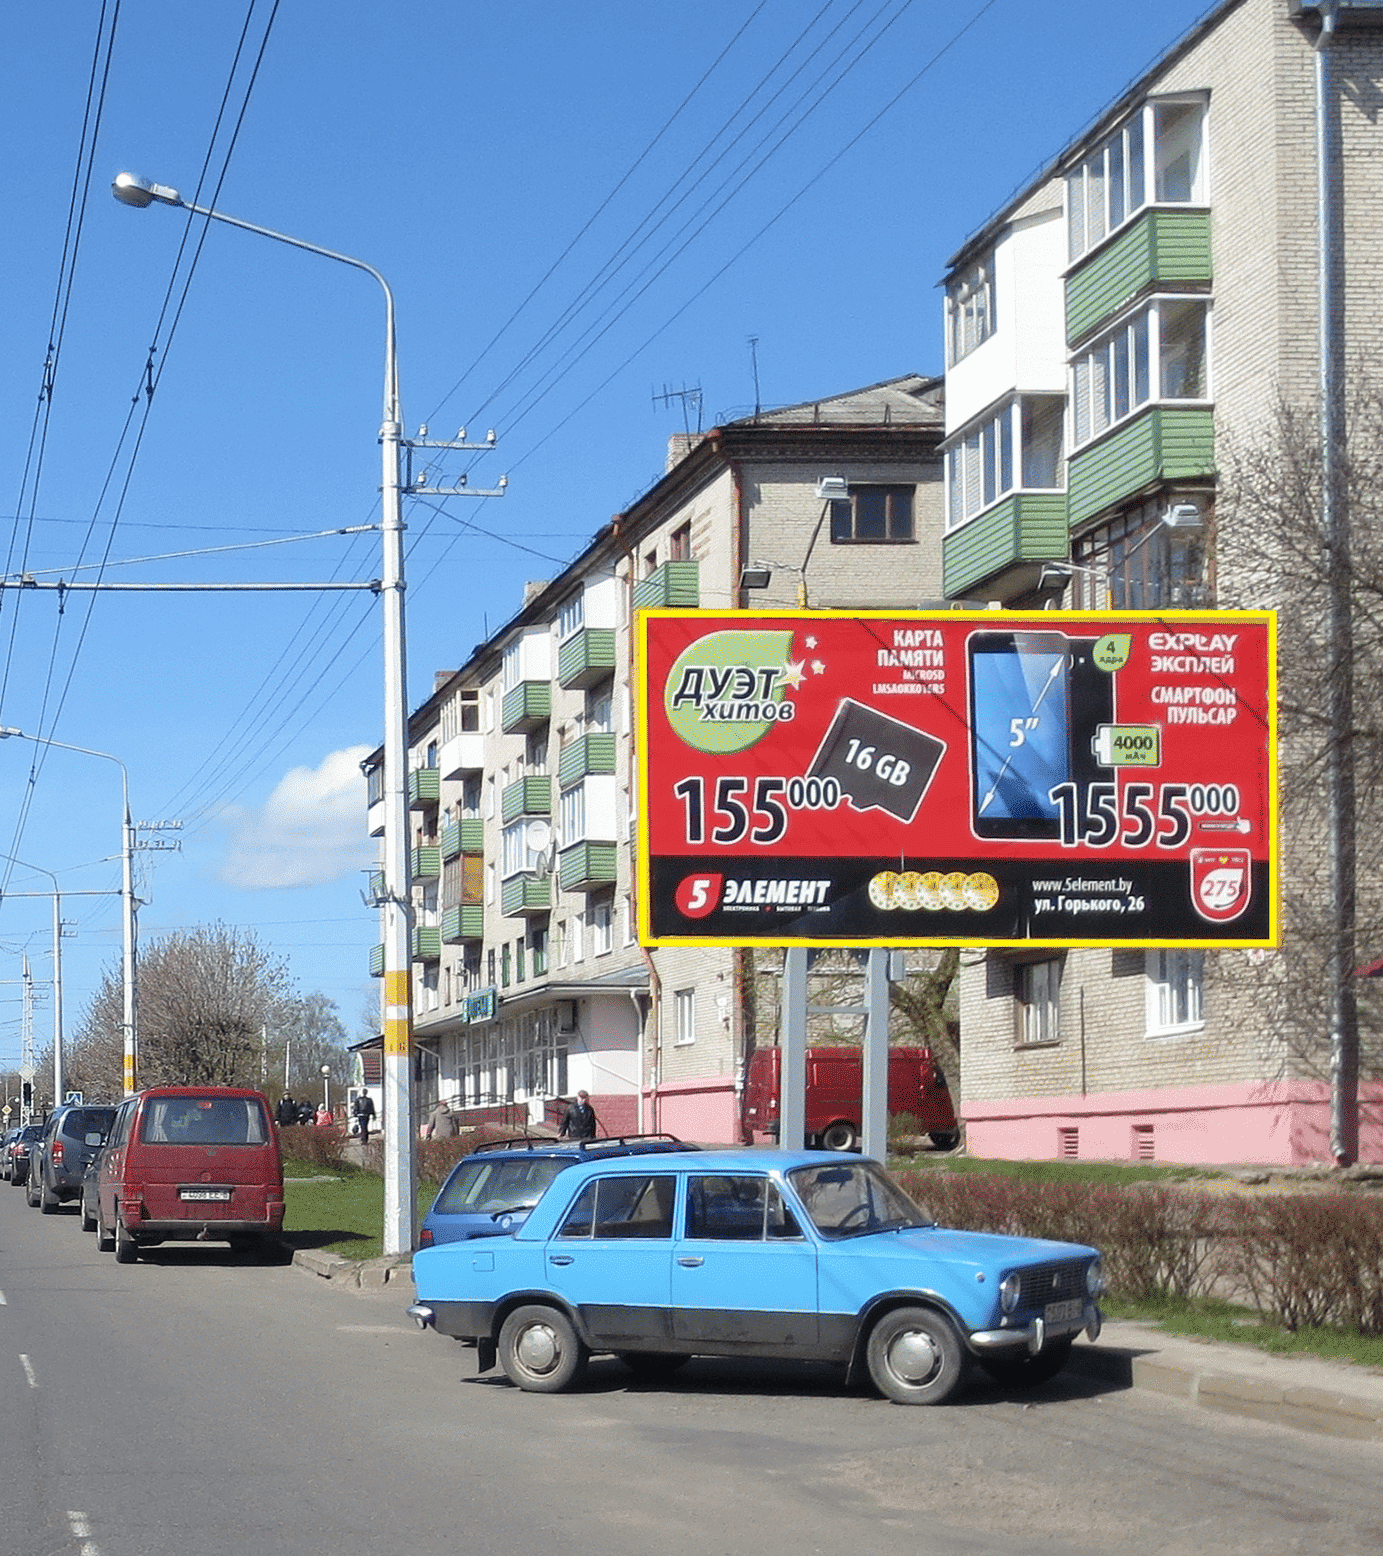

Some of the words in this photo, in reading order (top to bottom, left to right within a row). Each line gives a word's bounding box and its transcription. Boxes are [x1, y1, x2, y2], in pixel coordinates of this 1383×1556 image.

[893, 629, 944, 647] КАРТА
[1106, 641, 1116, 654] 4
[1148, 632, 1238, 651] EXPLAY
[877, 649, 944, 667] ПАМЯТИ
[1150, 654, 1235, 673] ЭКСПЛЕЙ
[672, 666, 782, 709] ДУЭТ
[1151, 686, 1237, 705] СМАРТФОН
[700, 701, 795, 722] хитов
[1167, 706, 1238, 724] ПУЛЬСАР
[1113, 736, 1153, 750] 4000
[844, 738, 875, 771] 16
[875, 755, 912, 787] GB
[688, 880, 711, 909] 5
[723, 880, 831, 904] ЭЛЕМЕНТ
[1032, 877, 1134, 895] www.5element.by
[1204, 880, 1238, 896] 275
[1034, 899, 1056, 915] ул.
[1058, 895, 1126, 915] Горького,
[1127, 895, 1145, 911] 26
